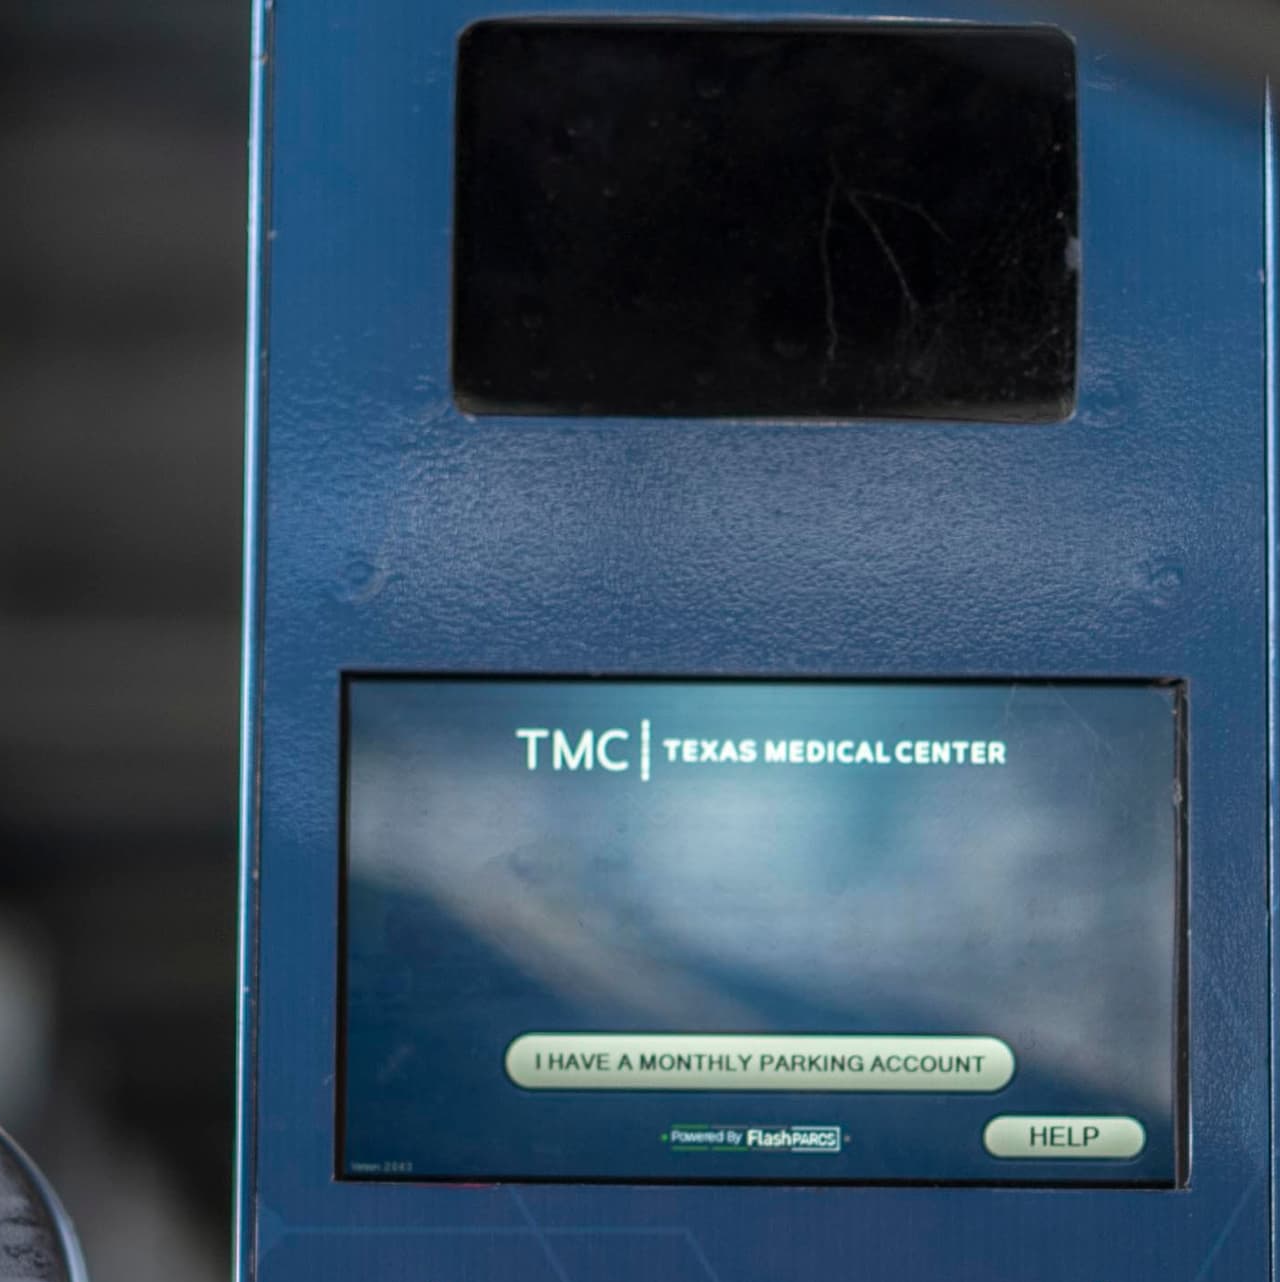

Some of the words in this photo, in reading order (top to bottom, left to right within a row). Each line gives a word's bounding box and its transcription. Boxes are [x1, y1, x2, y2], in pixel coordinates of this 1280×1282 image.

[515, 728, 629, 771] TMC
[662, 738, 758, 763] TEXAS
[764, 739, 891, 764] MEDICAL
[894, 740, 1007, 764] CENTER
[535, 1053, 542, 1071] I
[548, 1053, 610, 1071] HAVE
[617, 1053, 634, 1071] A
[640, 1054, 753, 1072] MONTHLY
[760, 1054, 865, 1073] PARKING
[871, 1055, 986, 1074] ACCOUNT
[671, 1130, 724, 1143] Powered
[727, 1130, 743, 1146] By
[1029, 1125, 1100, 1147] HELP
